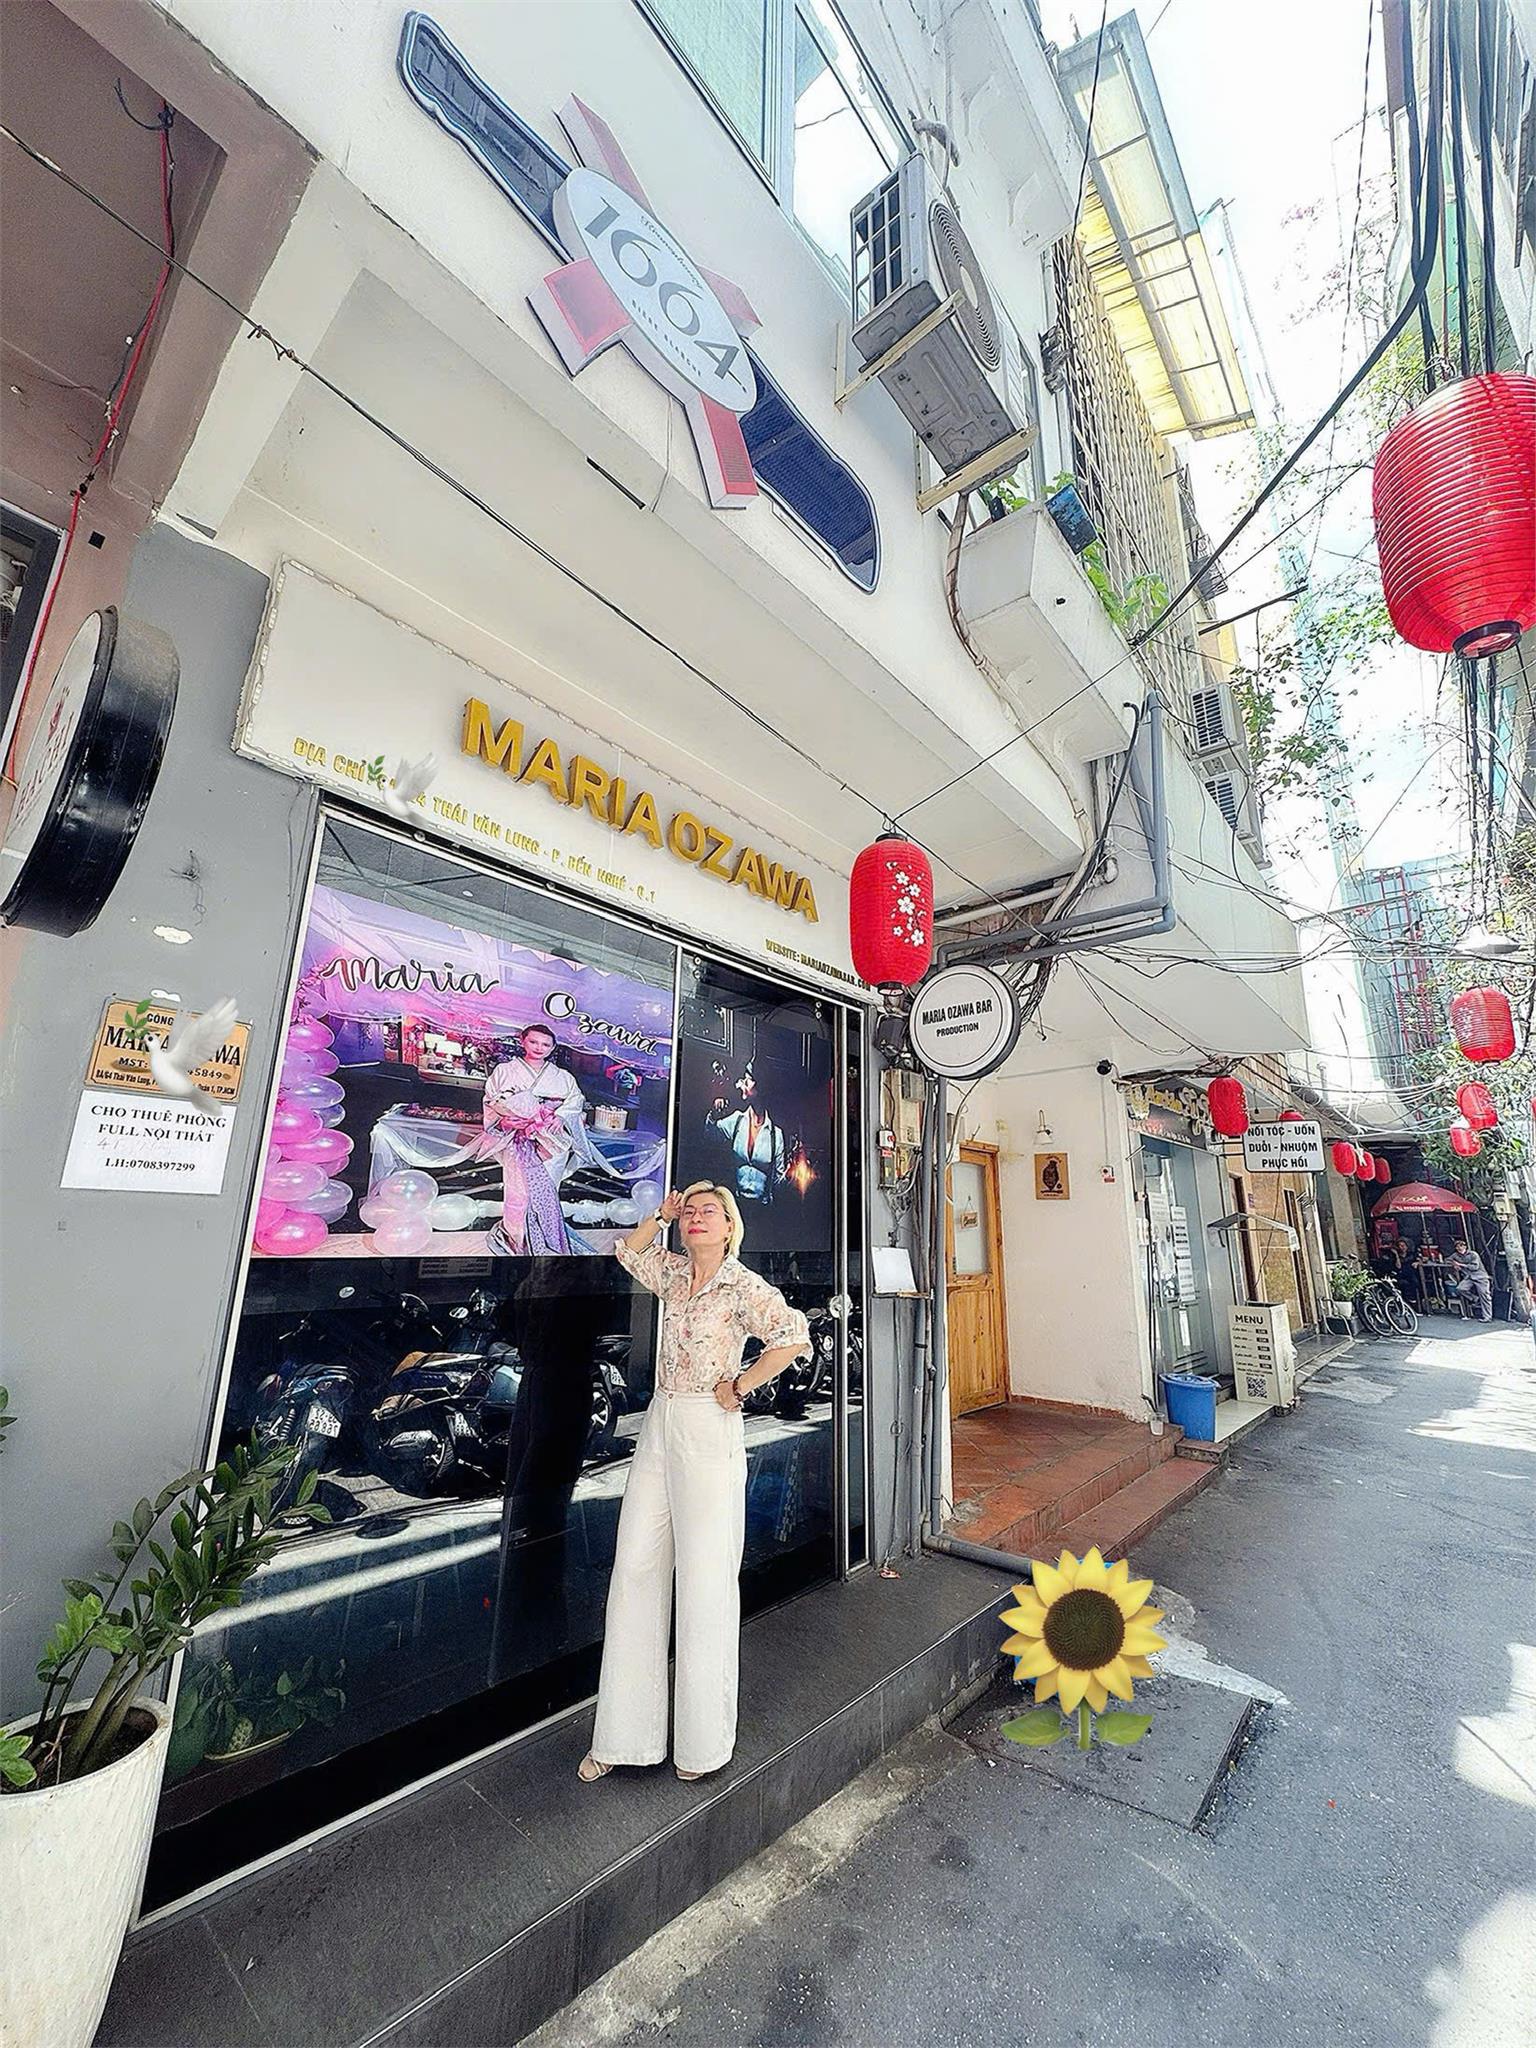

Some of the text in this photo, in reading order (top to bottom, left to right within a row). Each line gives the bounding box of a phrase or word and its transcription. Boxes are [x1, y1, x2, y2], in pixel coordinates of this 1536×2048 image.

[585, 197, 747, 393] 1664
[294, 737, 328, 766] ĐỊA
[433, 796, 469, 826] THÁI
[473, 813, 501, 839] VĂN
[505, 828, 540, 856] LUNG
[462, 697, 820, 923] MARIA OZAWA
[543, 992, 657, 1057] Ozawa
[922, 999, 993, 1026] MARIA OZAWA BAR
[936, 1022, 979, 1038] PRODUCTION
[118, 1057, 149, 1070] MST:
[91, 1104, 226, 1128] CHO THUÊ PHÒNG
[98, 1123, 139, 1137] FULL
[1234, 1314, 1264, 1325] MENU
